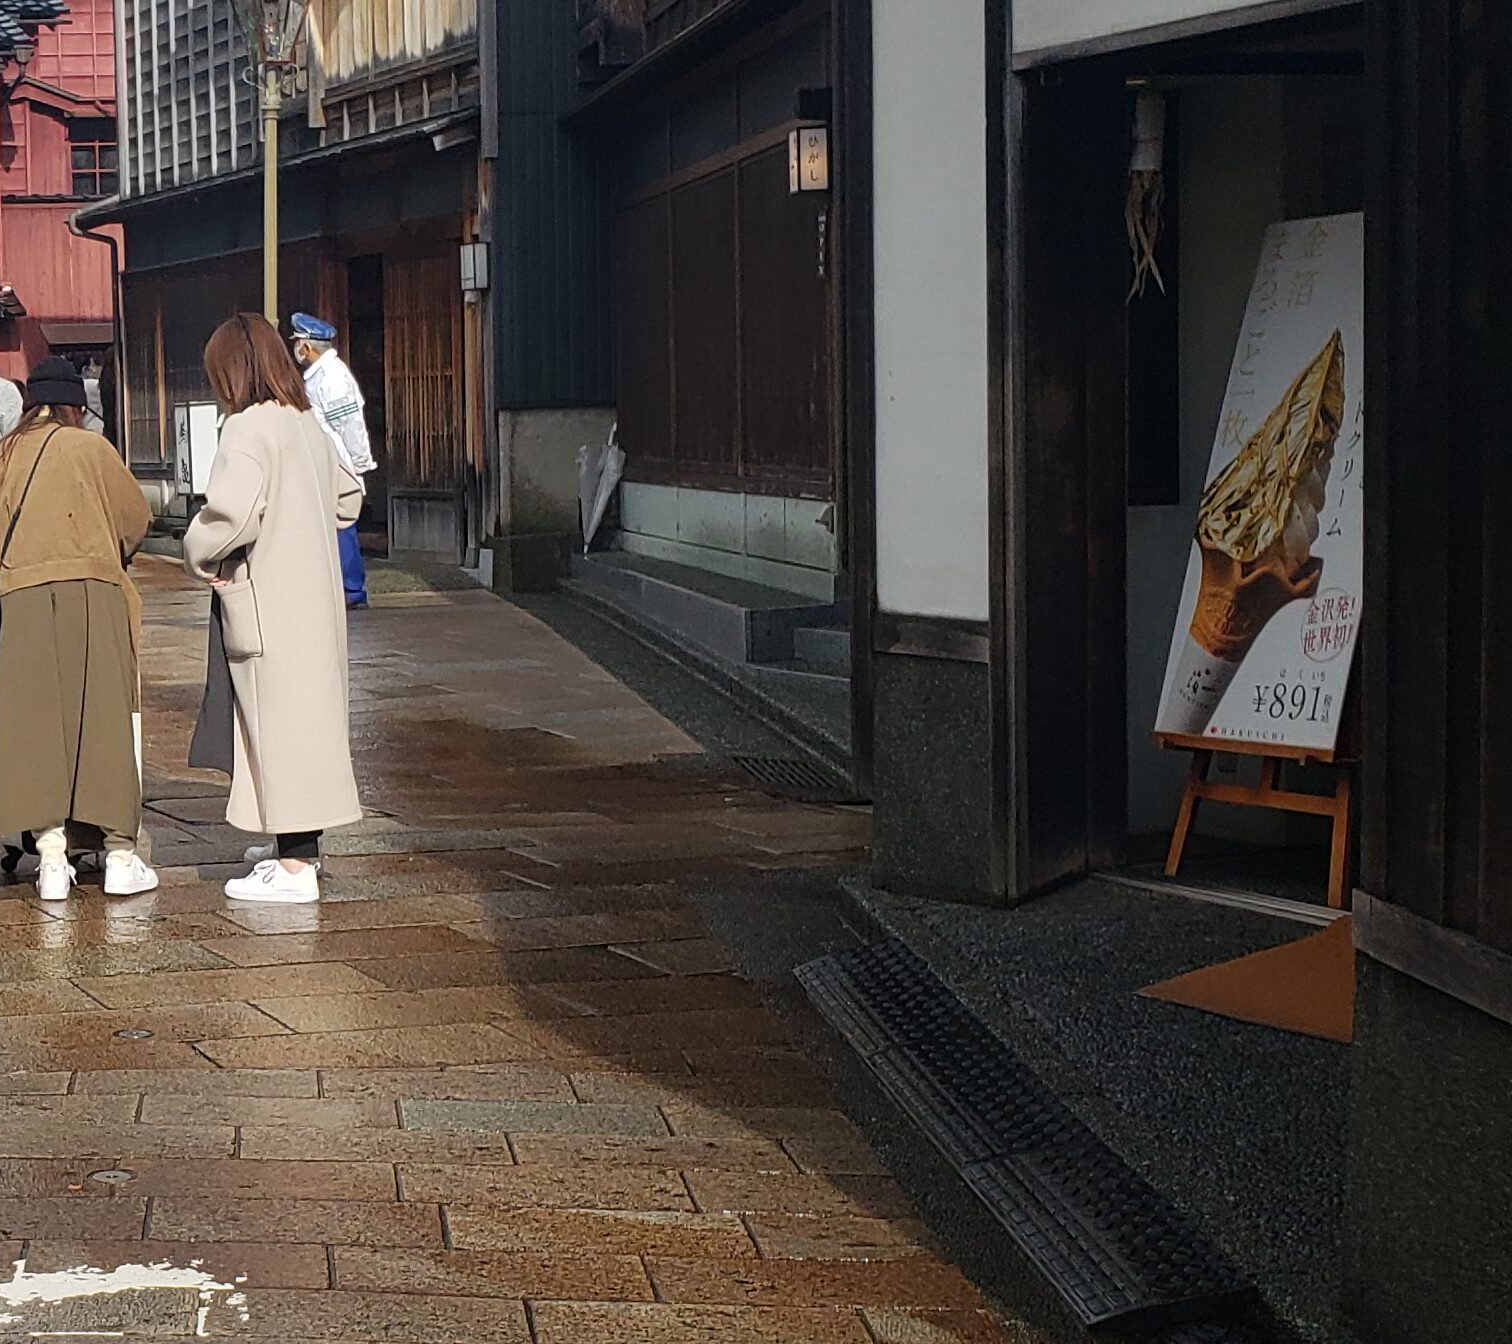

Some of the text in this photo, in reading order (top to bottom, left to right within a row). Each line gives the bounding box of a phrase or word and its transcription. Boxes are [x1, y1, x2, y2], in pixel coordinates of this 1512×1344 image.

[808, 136, 820, 182] ひがし
[1325, 388, 1364, 536] トクリーム
[1252, 682, 1321, 722] ¥891
